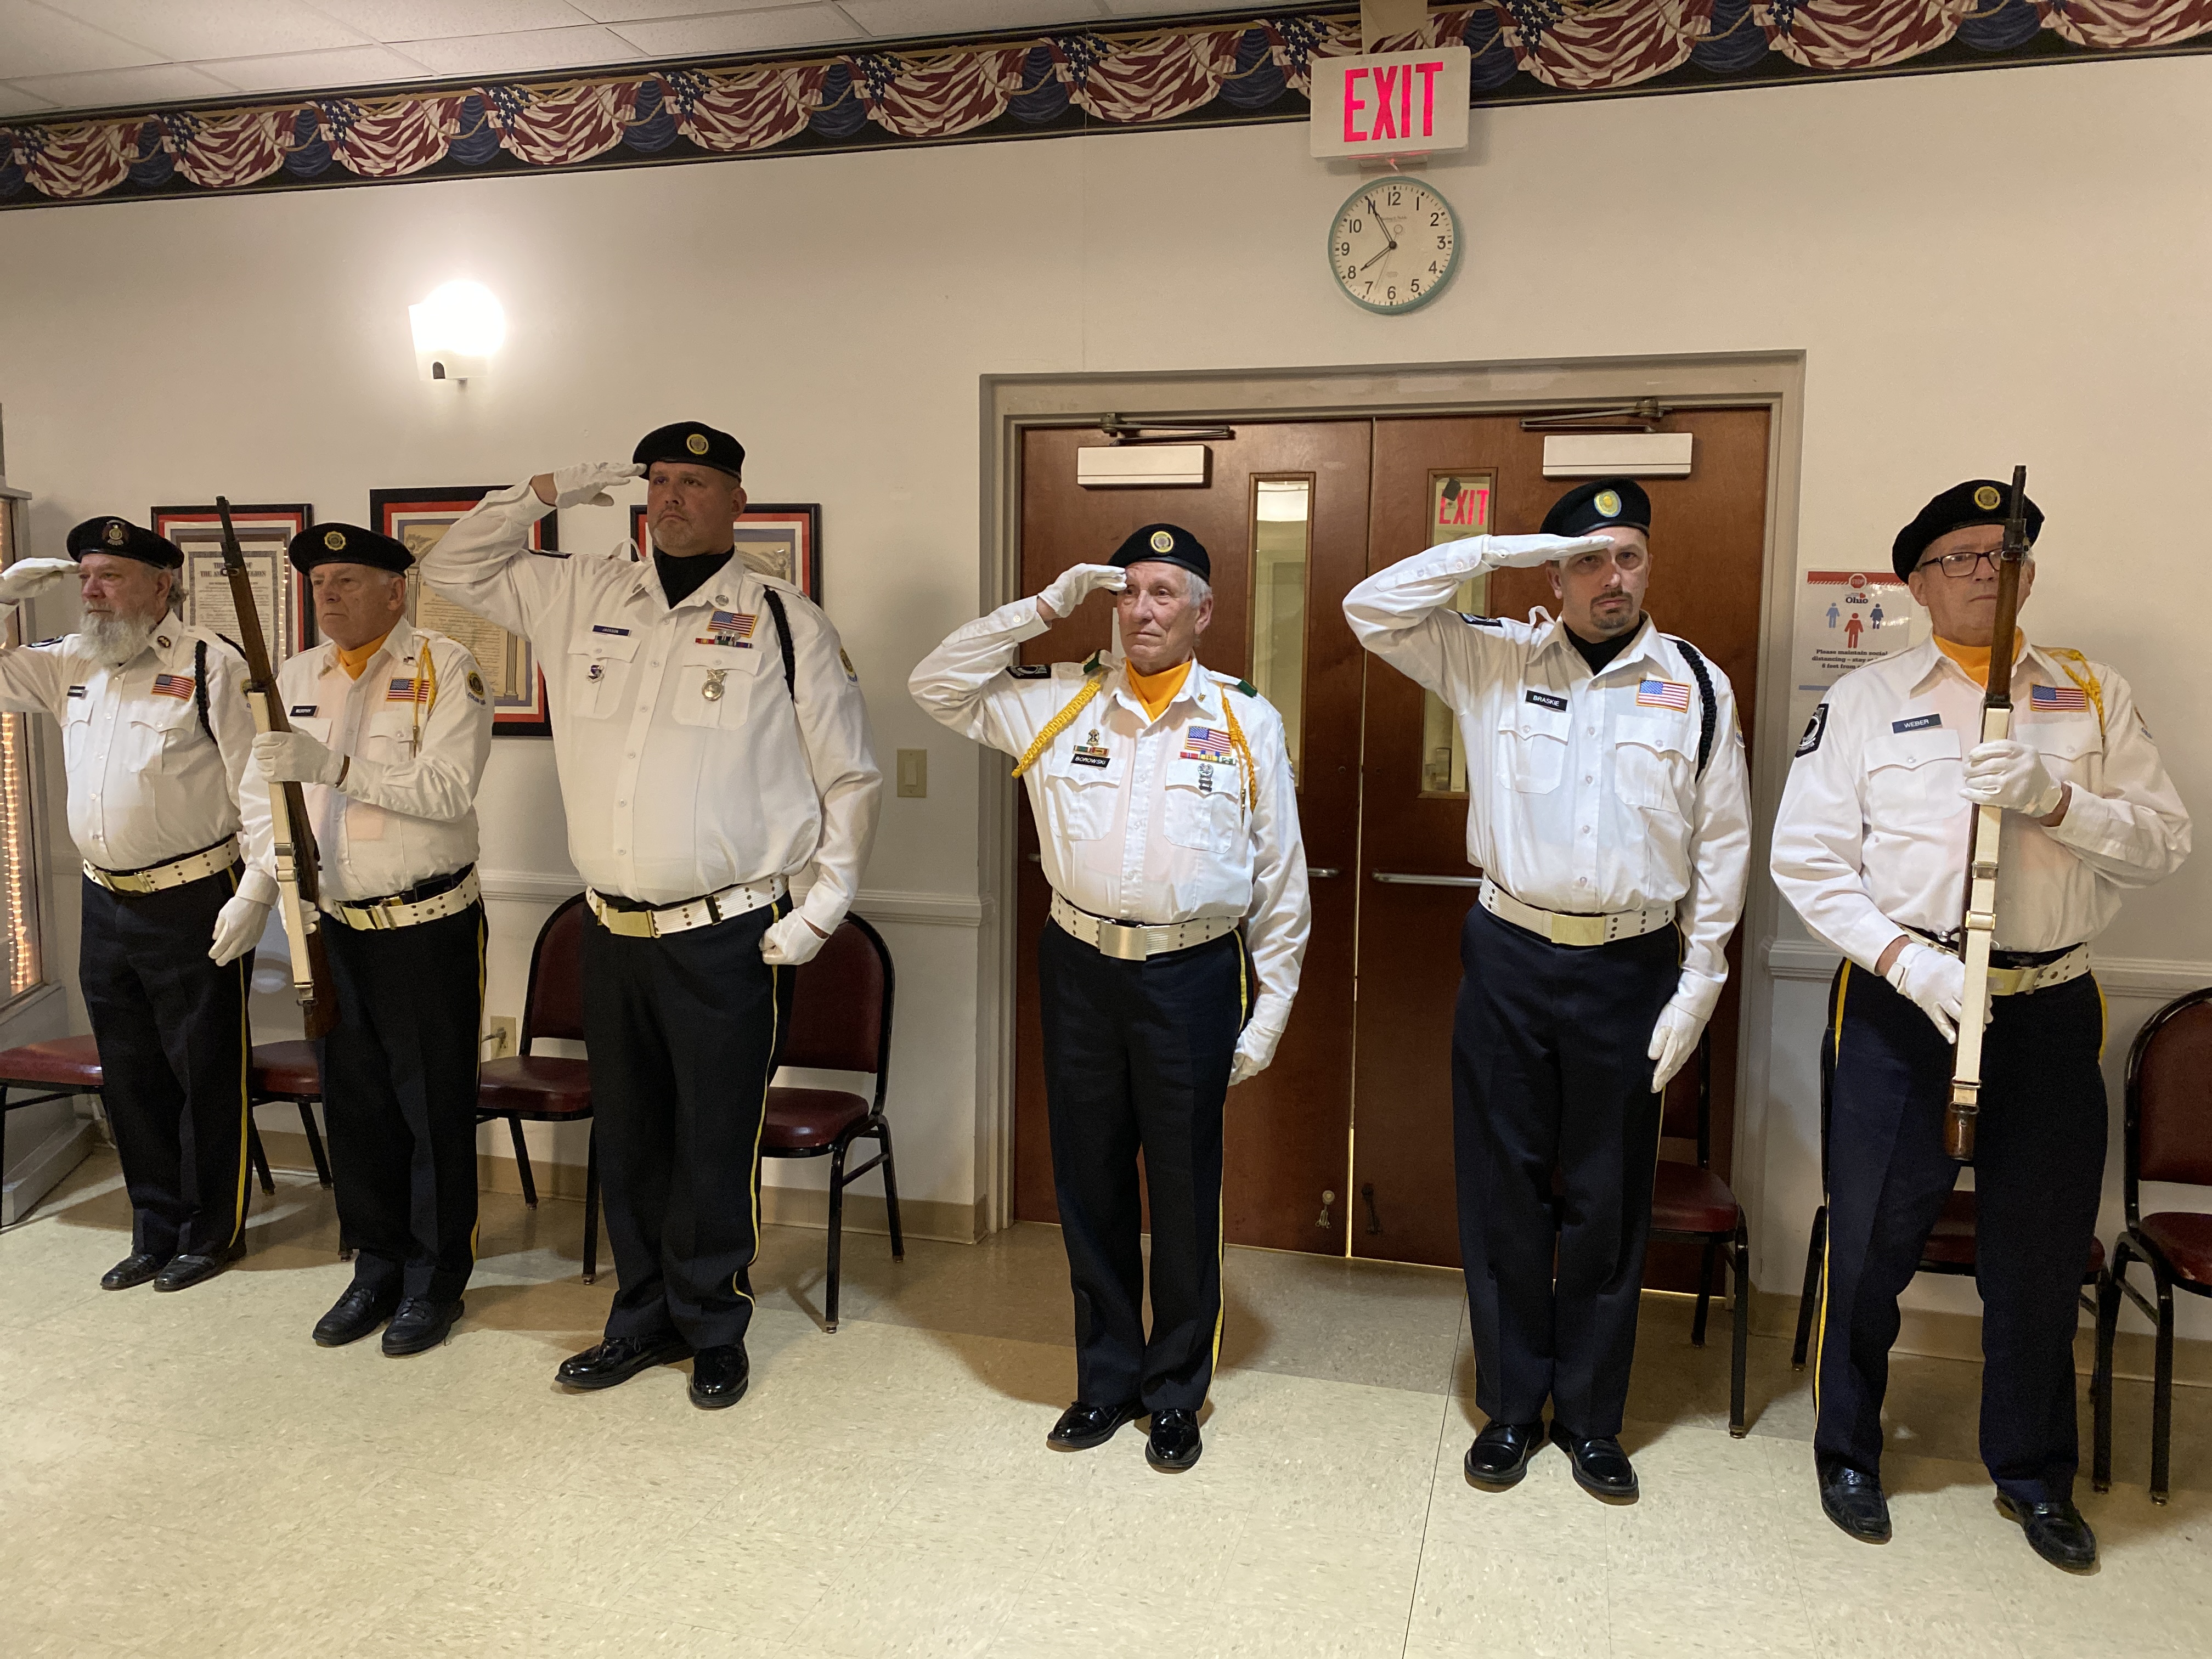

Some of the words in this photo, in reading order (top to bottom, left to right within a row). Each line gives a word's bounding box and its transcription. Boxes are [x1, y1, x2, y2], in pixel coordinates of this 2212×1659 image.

[1344, 61, 1443, 142] EXIT
[1388, 191, 1401, 206] 12
[1416, 196, 1420, 211] 1
[1350, 219, 1362, 233] 10
[1430, 212, 1439, 227] 2
[1341, 242, 1350, 256] 9
[1437, 235, 1446, 250] 3
[1347, 266, 1356, 279] 8
[1428, 260, 1437, 274] 4
[1364, 281, 1373, 295] 7
[1410, 279, 1419, 292] 5
[1387, 286, 1396, 300] 6
[1439, 489, 1489, 525] EXIT
[1533, 695, 1559, 707] BRASKIE
[1904, 719, 1929, 728] WEBER
[1075, 756, 1106, 765] BOROWSKI
